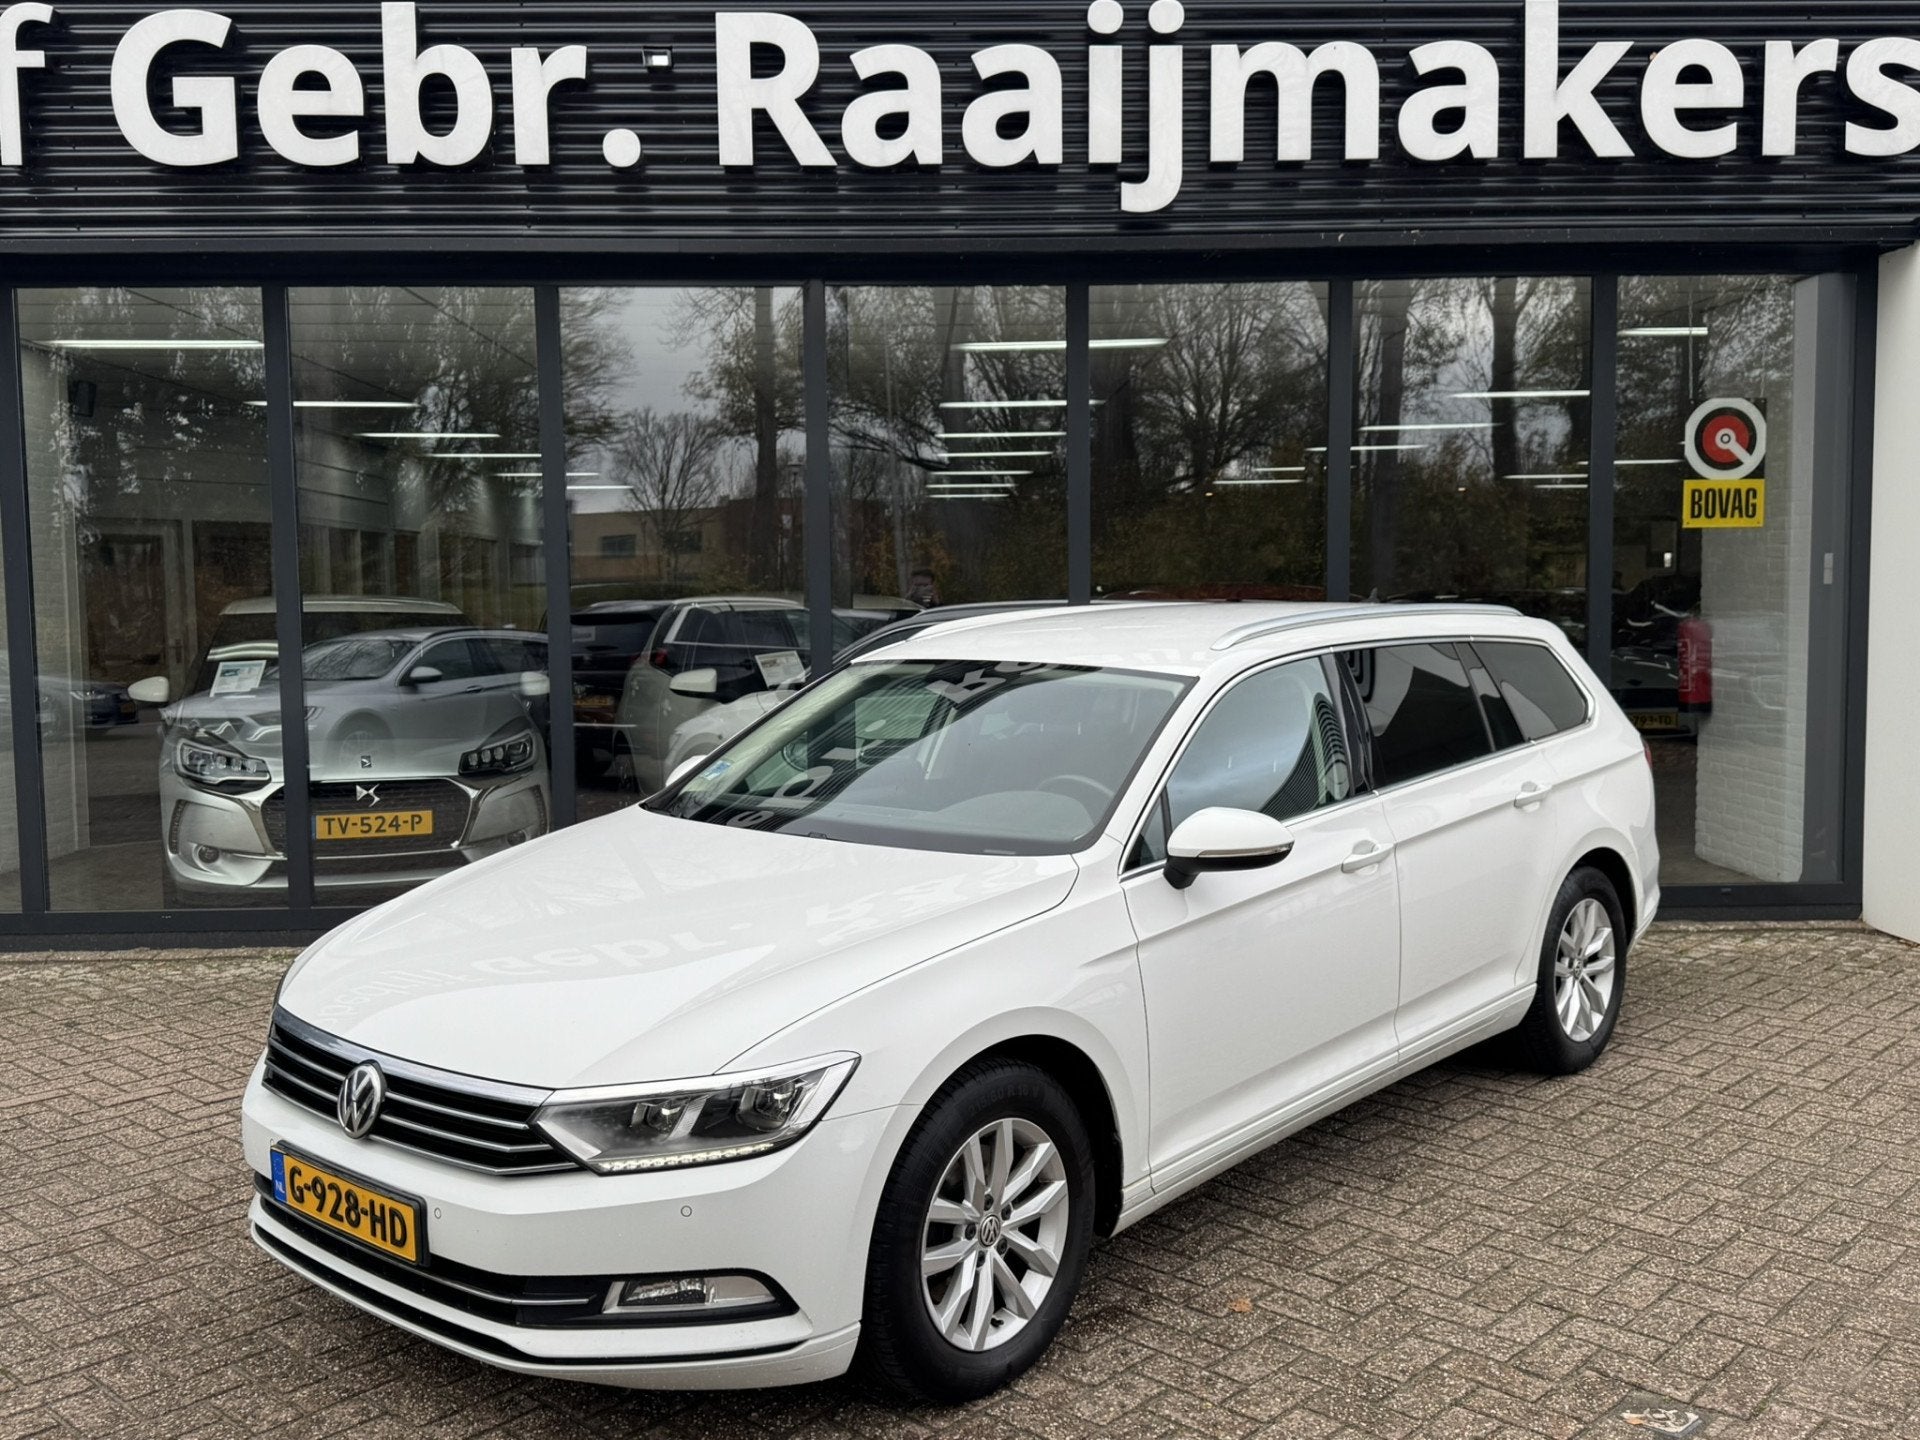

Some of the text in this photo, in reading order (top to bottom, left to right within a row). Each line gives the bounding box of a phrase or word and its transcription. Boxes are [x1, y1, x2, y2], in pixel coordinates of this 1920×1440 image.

[110, 1, 642, 168] Gebr.
[715, 0, 1920, 213] Raaijmakers
[1690, 487, 1757, 519] BOVAG
[323, 814, 423, 835] TV-524-P
[274, 1180, 285, 1194] NL
[289, 1165, 407, 1248] G-928-HD
